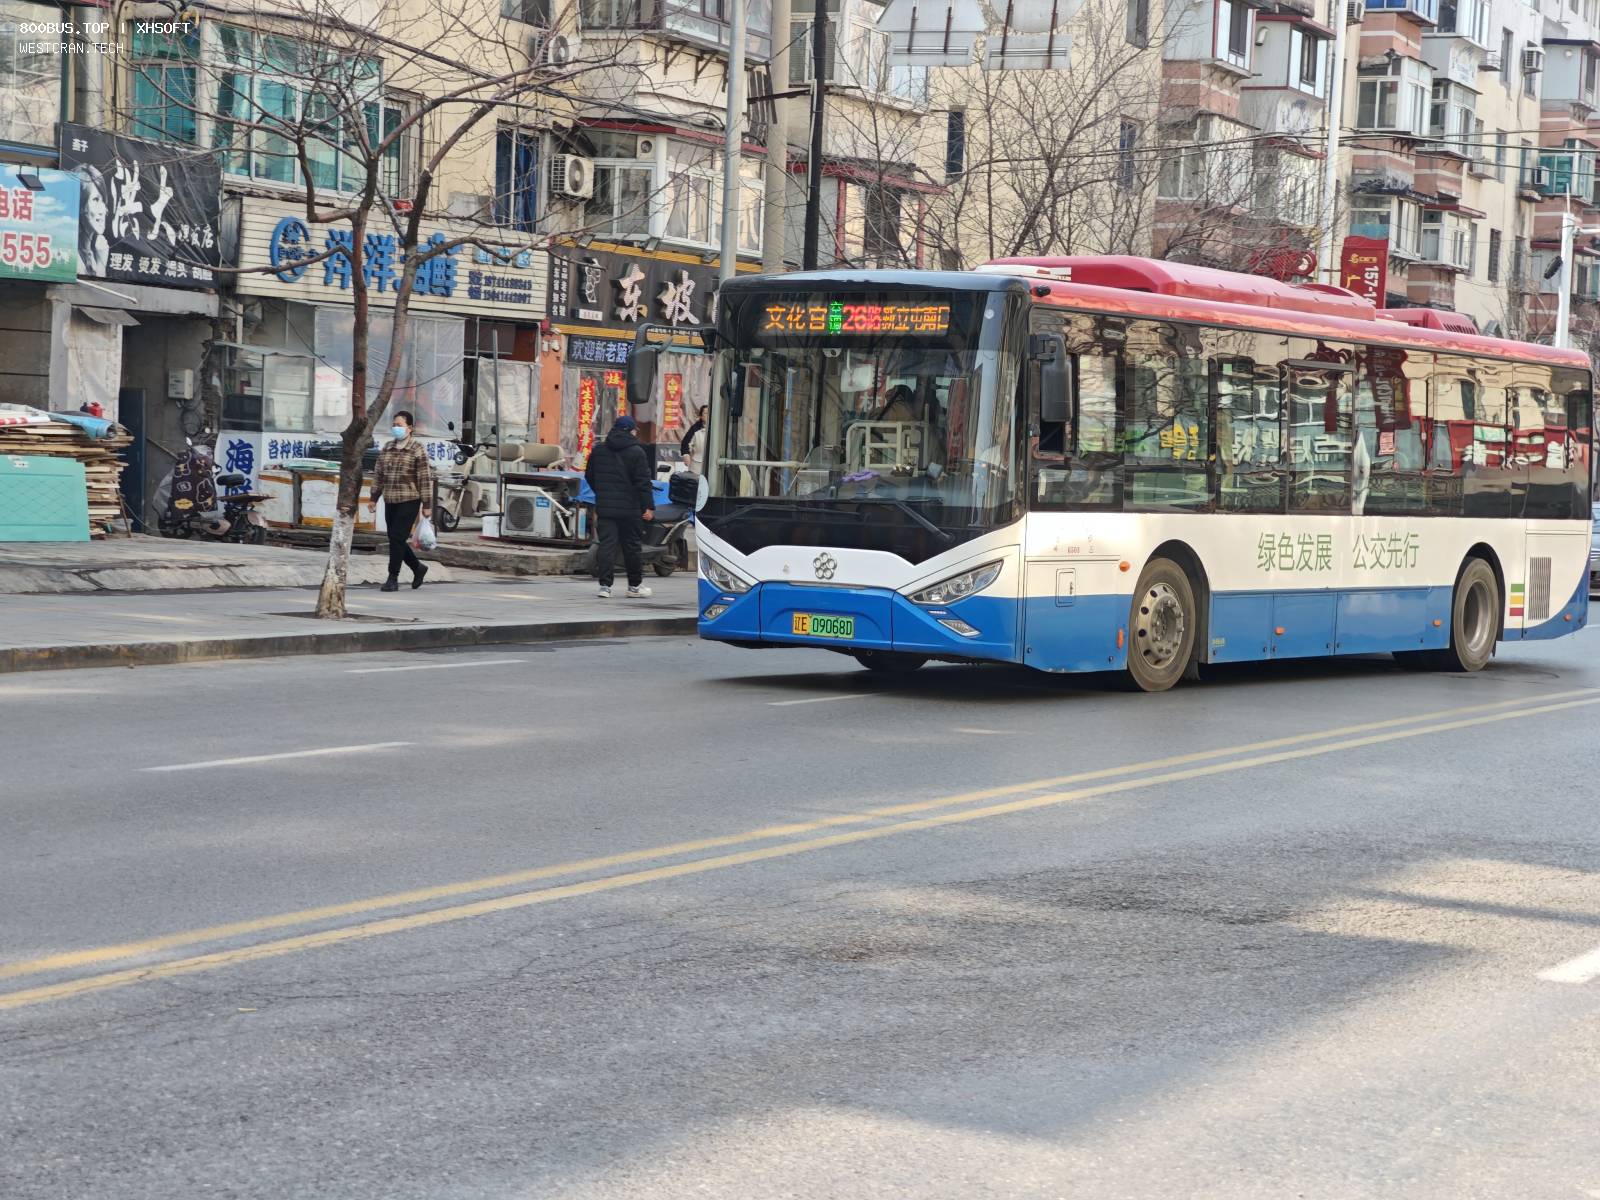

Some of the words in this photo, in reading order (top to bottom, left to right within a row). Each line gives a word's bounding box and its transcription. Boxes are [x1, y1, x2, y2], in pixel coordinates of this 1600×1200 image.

[110, 252, 134, 272] 理发
[612, 263, 719, 327] 东坡
[765, 304, 828, 331] 文化宫
[1256, 531, 1332, 572] 绿色发展
[1352, 531, 1420, 571] 公交先行
[812, 617, 853, 636] 09068D
